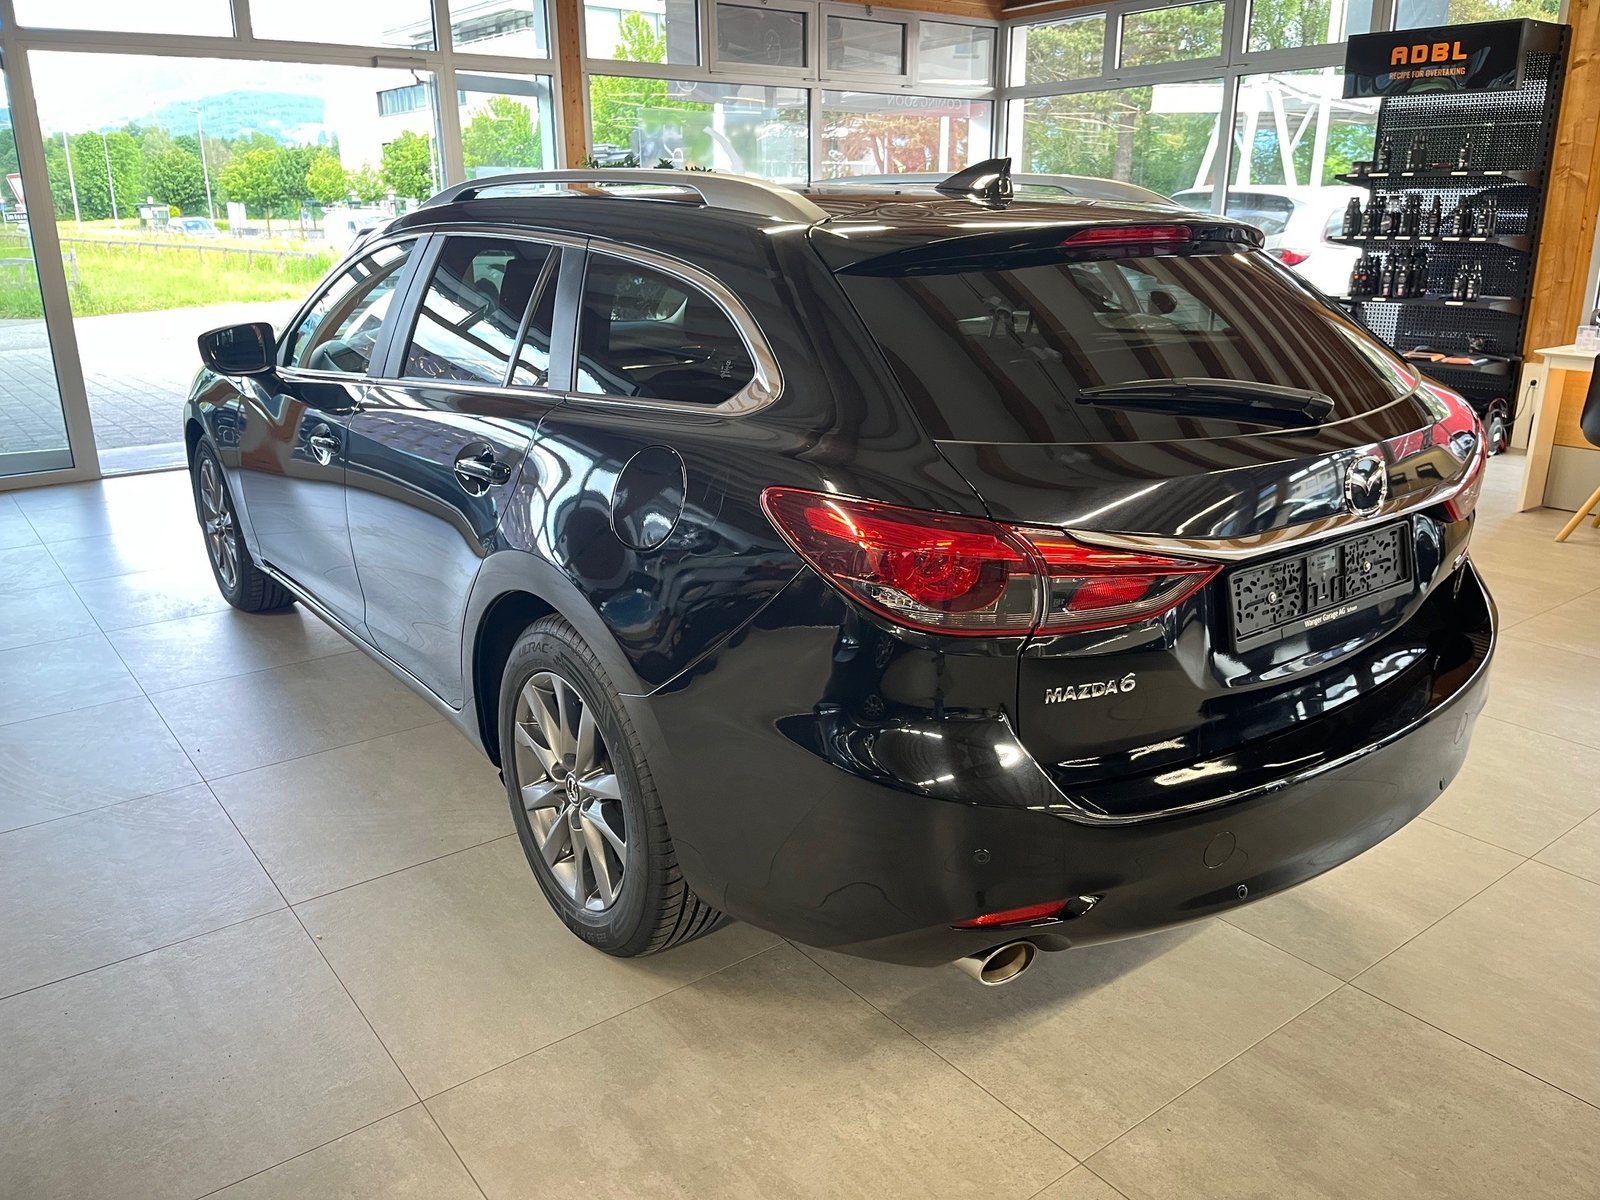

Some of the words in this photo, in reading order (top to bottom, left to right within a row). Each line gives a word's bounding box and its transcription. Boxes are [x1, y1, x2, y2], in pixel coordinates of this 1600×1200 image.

[1391, 41, 1467, 65] ADBL
[1389, 71, 1411, 80] RECIPE
[1412, 69, 1424, 78] FOR
[1425, 67, 1466, 77] OVERTAKING
[1339, 606, 1346, 616] AG
